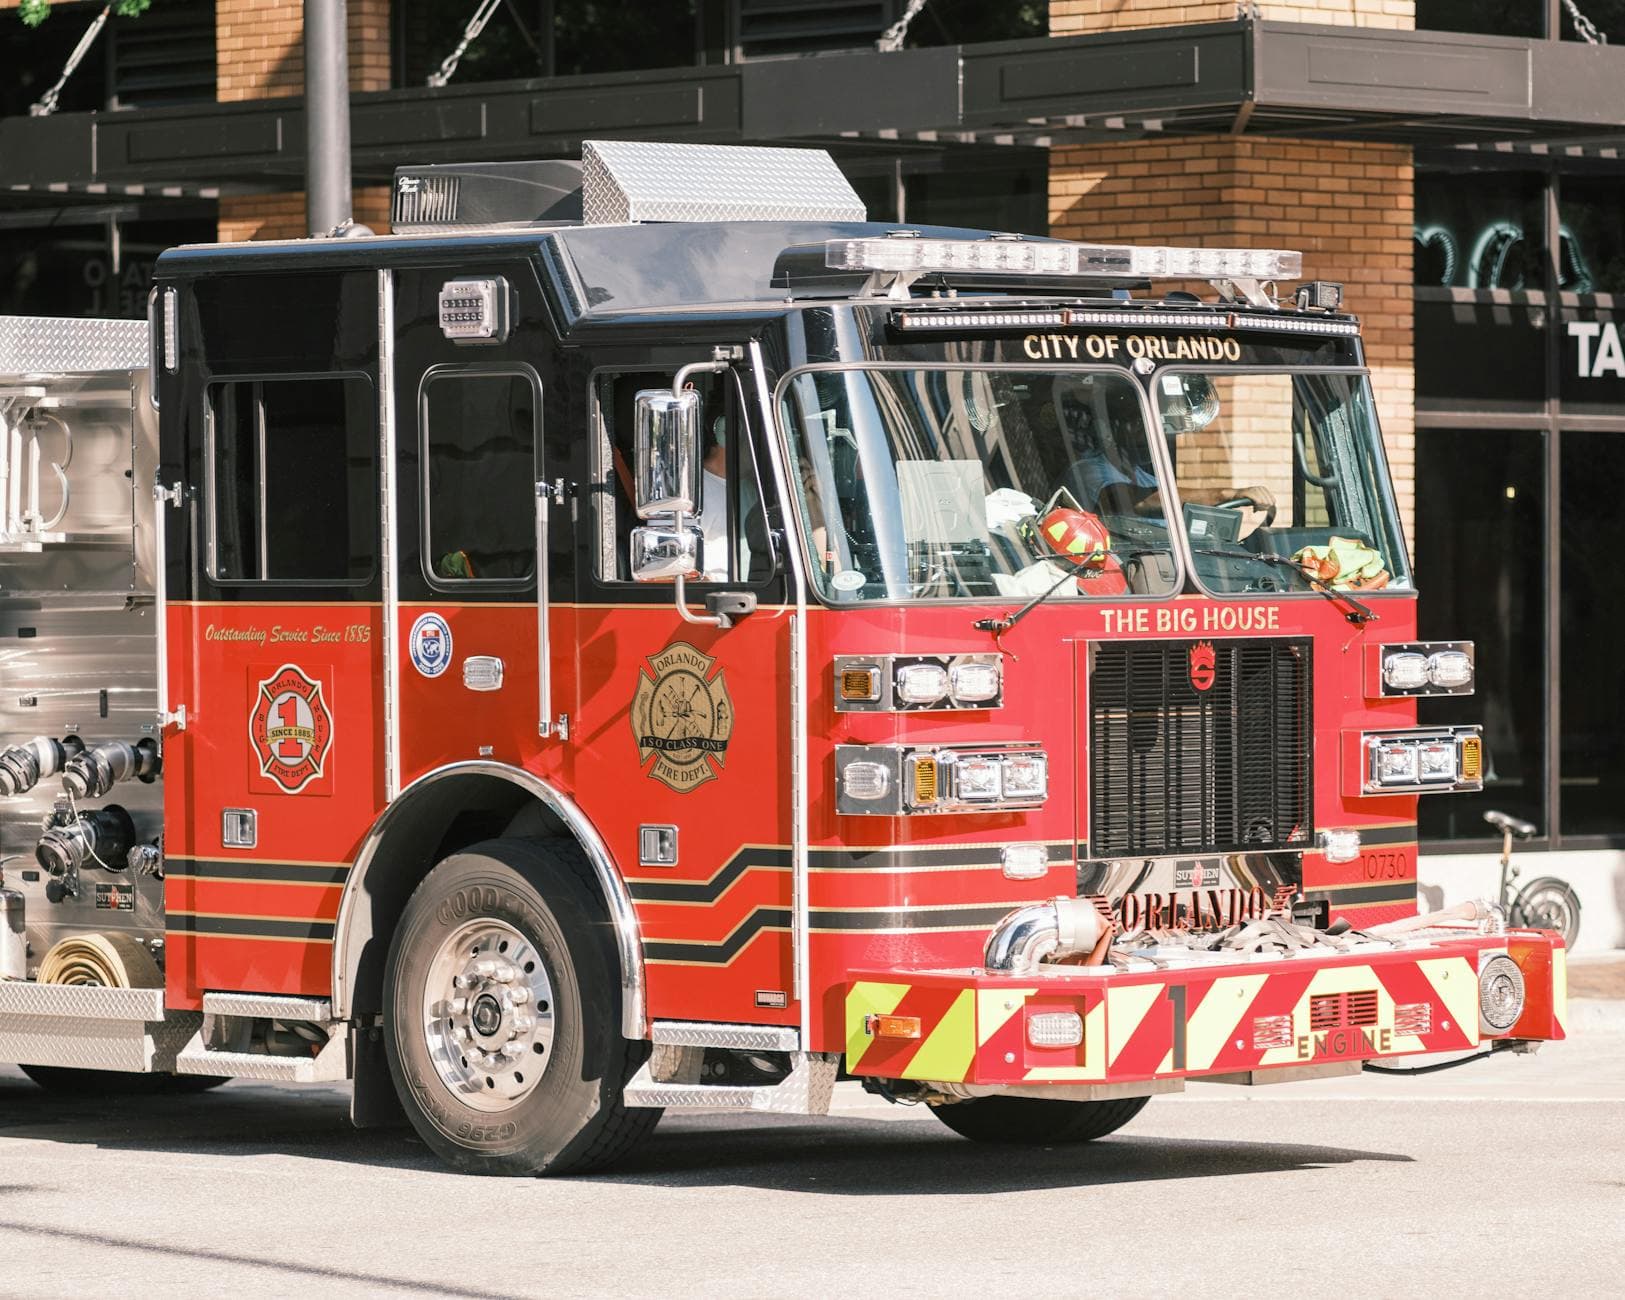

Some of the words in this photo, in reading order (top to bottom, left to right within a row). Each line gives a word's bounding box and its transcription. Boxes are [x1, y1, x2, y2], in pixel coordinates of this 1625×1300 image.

[1023, 334, 1079, 359] CITY
[1085, 334, 1119, 359] OF
[1126, 335, 1241, 361] ORLANDO
[1568, 321, 1625, 378] TA
[1100, 608, 1150, 633] THE
[1156, 607, 1198, 632] BIG
[1203, 606, 1280, 631] HOUSE
[205, 624, 267, 647] Outstanding
[270, 625, 308, 643] Service
[311, 625, 341, 643] Since
[343, 624, 372, 643] 1885
[656, 652, 707, 672] ORLANDO
[270, 679, 308, 694] ORLANDO
[271, 728, 293, 738] SINCE
[278, 696, 303, 758] 1
[643, 737, 663, 748] ISO
[665, 738, 698, 750] CLASS
[701, 741, 724, 751] ONE
[274, 763, 290, 778] FIRE
[657, 761, 678, 781] FIRE
[1360, 853, 1407, 880] 10730
[1119, 885, 1266, 933] ORLANDO
[1167, 984, 1188, 1071] 1
[1296, 1028, 1392, 1060] ENGINE
